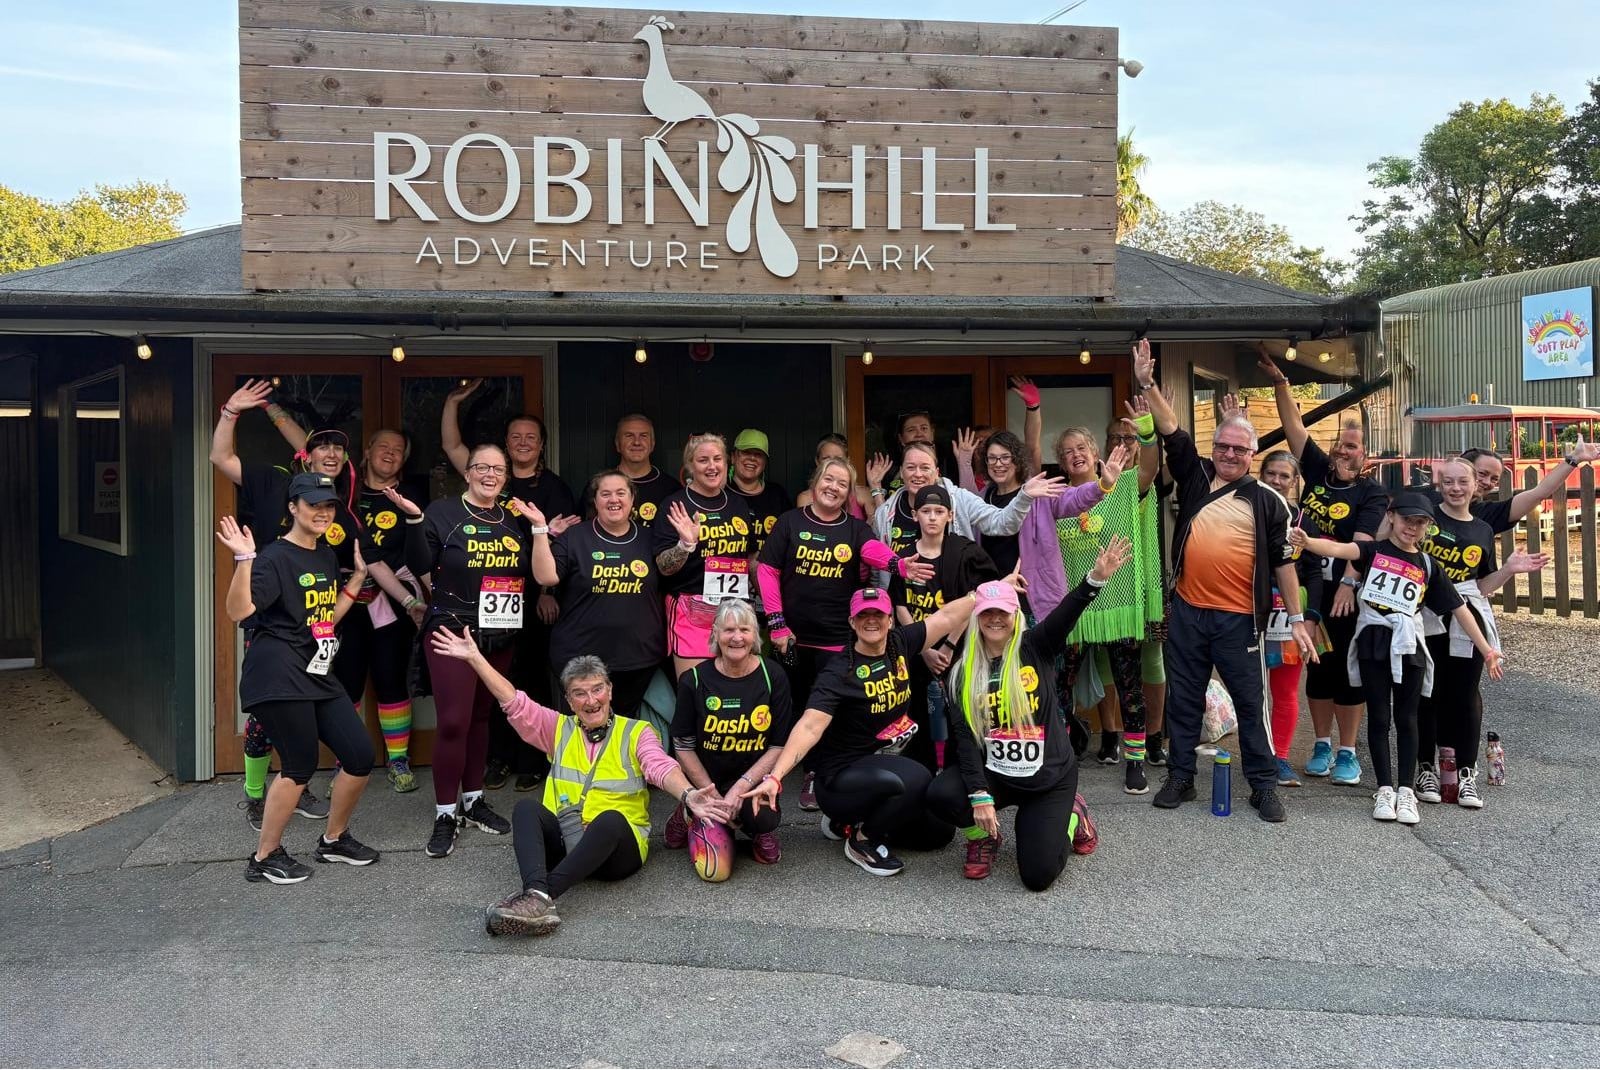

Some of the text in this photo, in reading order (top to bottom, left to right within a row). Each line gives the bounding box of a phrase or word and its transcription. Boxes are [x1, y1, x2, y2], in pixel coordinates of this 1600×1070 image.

[374, 132, 1017, 231] ROBIN HILL
[415, 237, 935, 271] ADVENTURE PARK
[1537, 340, 1580, 354] SOFT PLAY
[1548, 352, 1569, 363] AREA
[1302, 492, 1328, 516] Das
[700, 522, 734, 541] Dash
[467, 539, 503, 552] Dash
[708, 539, 716, 548] in
[1423, 540, 1461, 563] Dash
[467, 553, 519, 568] the Dark
[476, 551, 484, 560] in
[701, 548, 715, 557] the
[796, 545, 832, 562] Dash
[592, 563, 629, 579] Dash
[795, 562, 844, 578] the Dark
[802, 559, 810, 568] in
[1443, 565, 1470, 581] ark
[592, 579, 644, 593] the Dark
[600, 578, 607, 586] in
[717, 574, 739, 593] 12
[1371, 572, 1418, 602] 416
[484, 593, 520, 614] 378
[871, 702, 886, 714] the
[703, 714, 750, 734] Dash
[703, 733, 766, 752] the Dark
[711, 733, 721, 743] in
[991, 740, 1040, 762] 380
